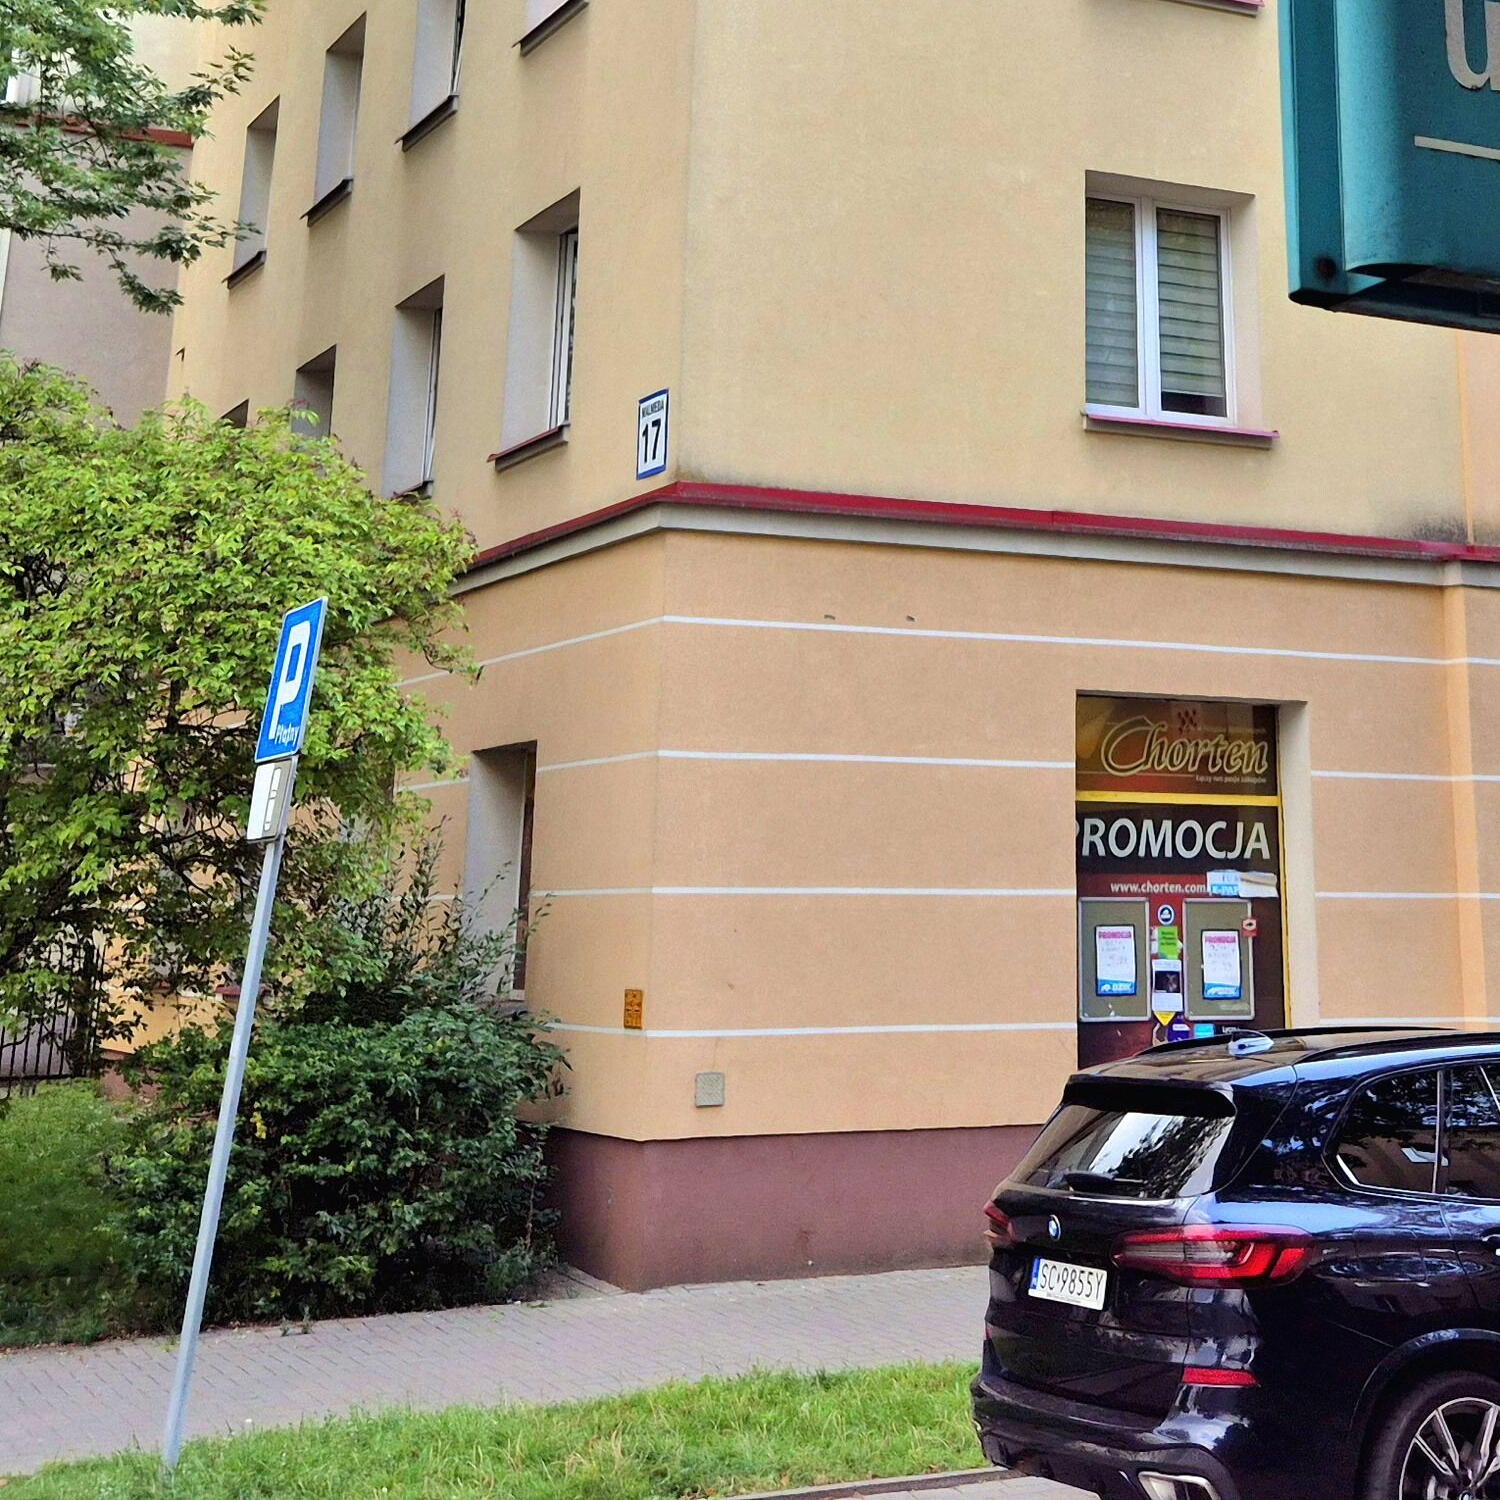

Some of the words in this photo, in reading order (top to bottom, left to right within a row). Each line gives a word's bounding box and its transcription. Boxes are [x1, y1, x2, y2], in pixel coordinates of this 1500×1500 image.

[641, 418, 661, 463] 17
[269, 620, 310, 740] P
[1101, 715, 1269, 777] Chorten
[1076, 817, 1271, 860] ROMOCJA
[1040, 1263, 1057, 1291] SC
[1060, 1267, 1104, 1301] 9855Y
